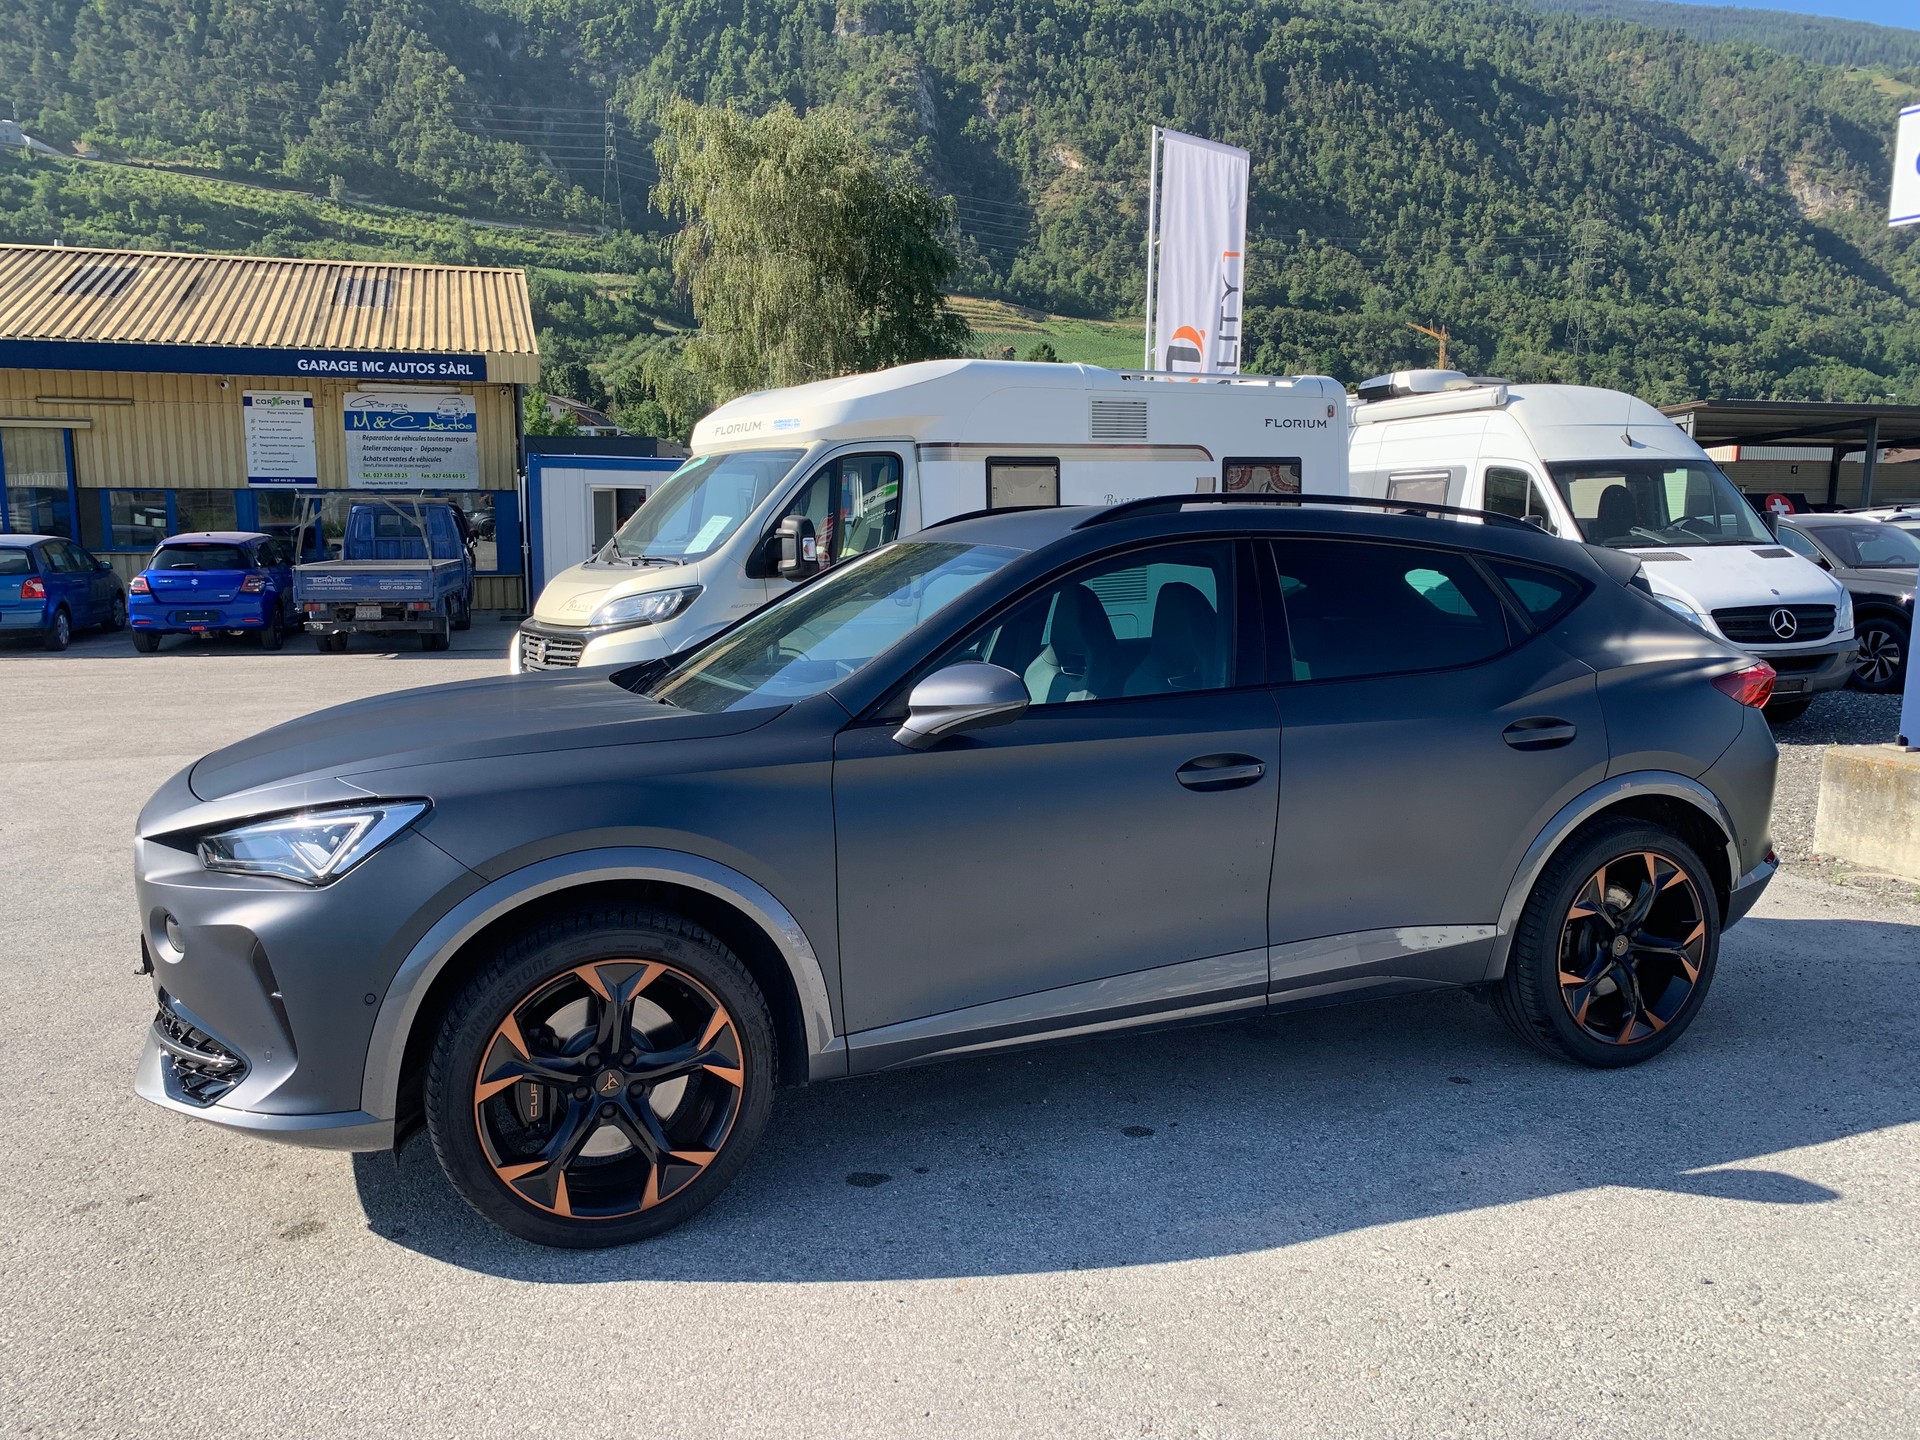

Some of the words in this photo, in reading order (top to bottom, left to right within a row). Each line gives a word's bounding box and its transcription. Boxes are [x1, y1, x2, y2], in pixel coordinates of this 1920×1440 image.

[297, 359, 358, 372] GARAGE
[362, 361, 385, 373] MC
[388, 362, 435, 374] AUTOS
[439, 361, 473, 375] SÀRL
[349, 394, 409, 414] Garage
[353, 411, 371, 430] M
[373, 416, 391, 429] &
[389, 415, 420, 429] C
[419, 416, 472, 430] Autos
[714, 420, 762, 437] FLORIUM
[1264, 418, 1328, 429] FLORIUM
[362, 434, 393, 442] Réparation
[362, 444, 381, 452] Atelier
[381, 445, 413, 453] mécanique
[420, 445, 452, 453] Dépannage
[463, 954, 552, 1049] BRIDGESTONE
